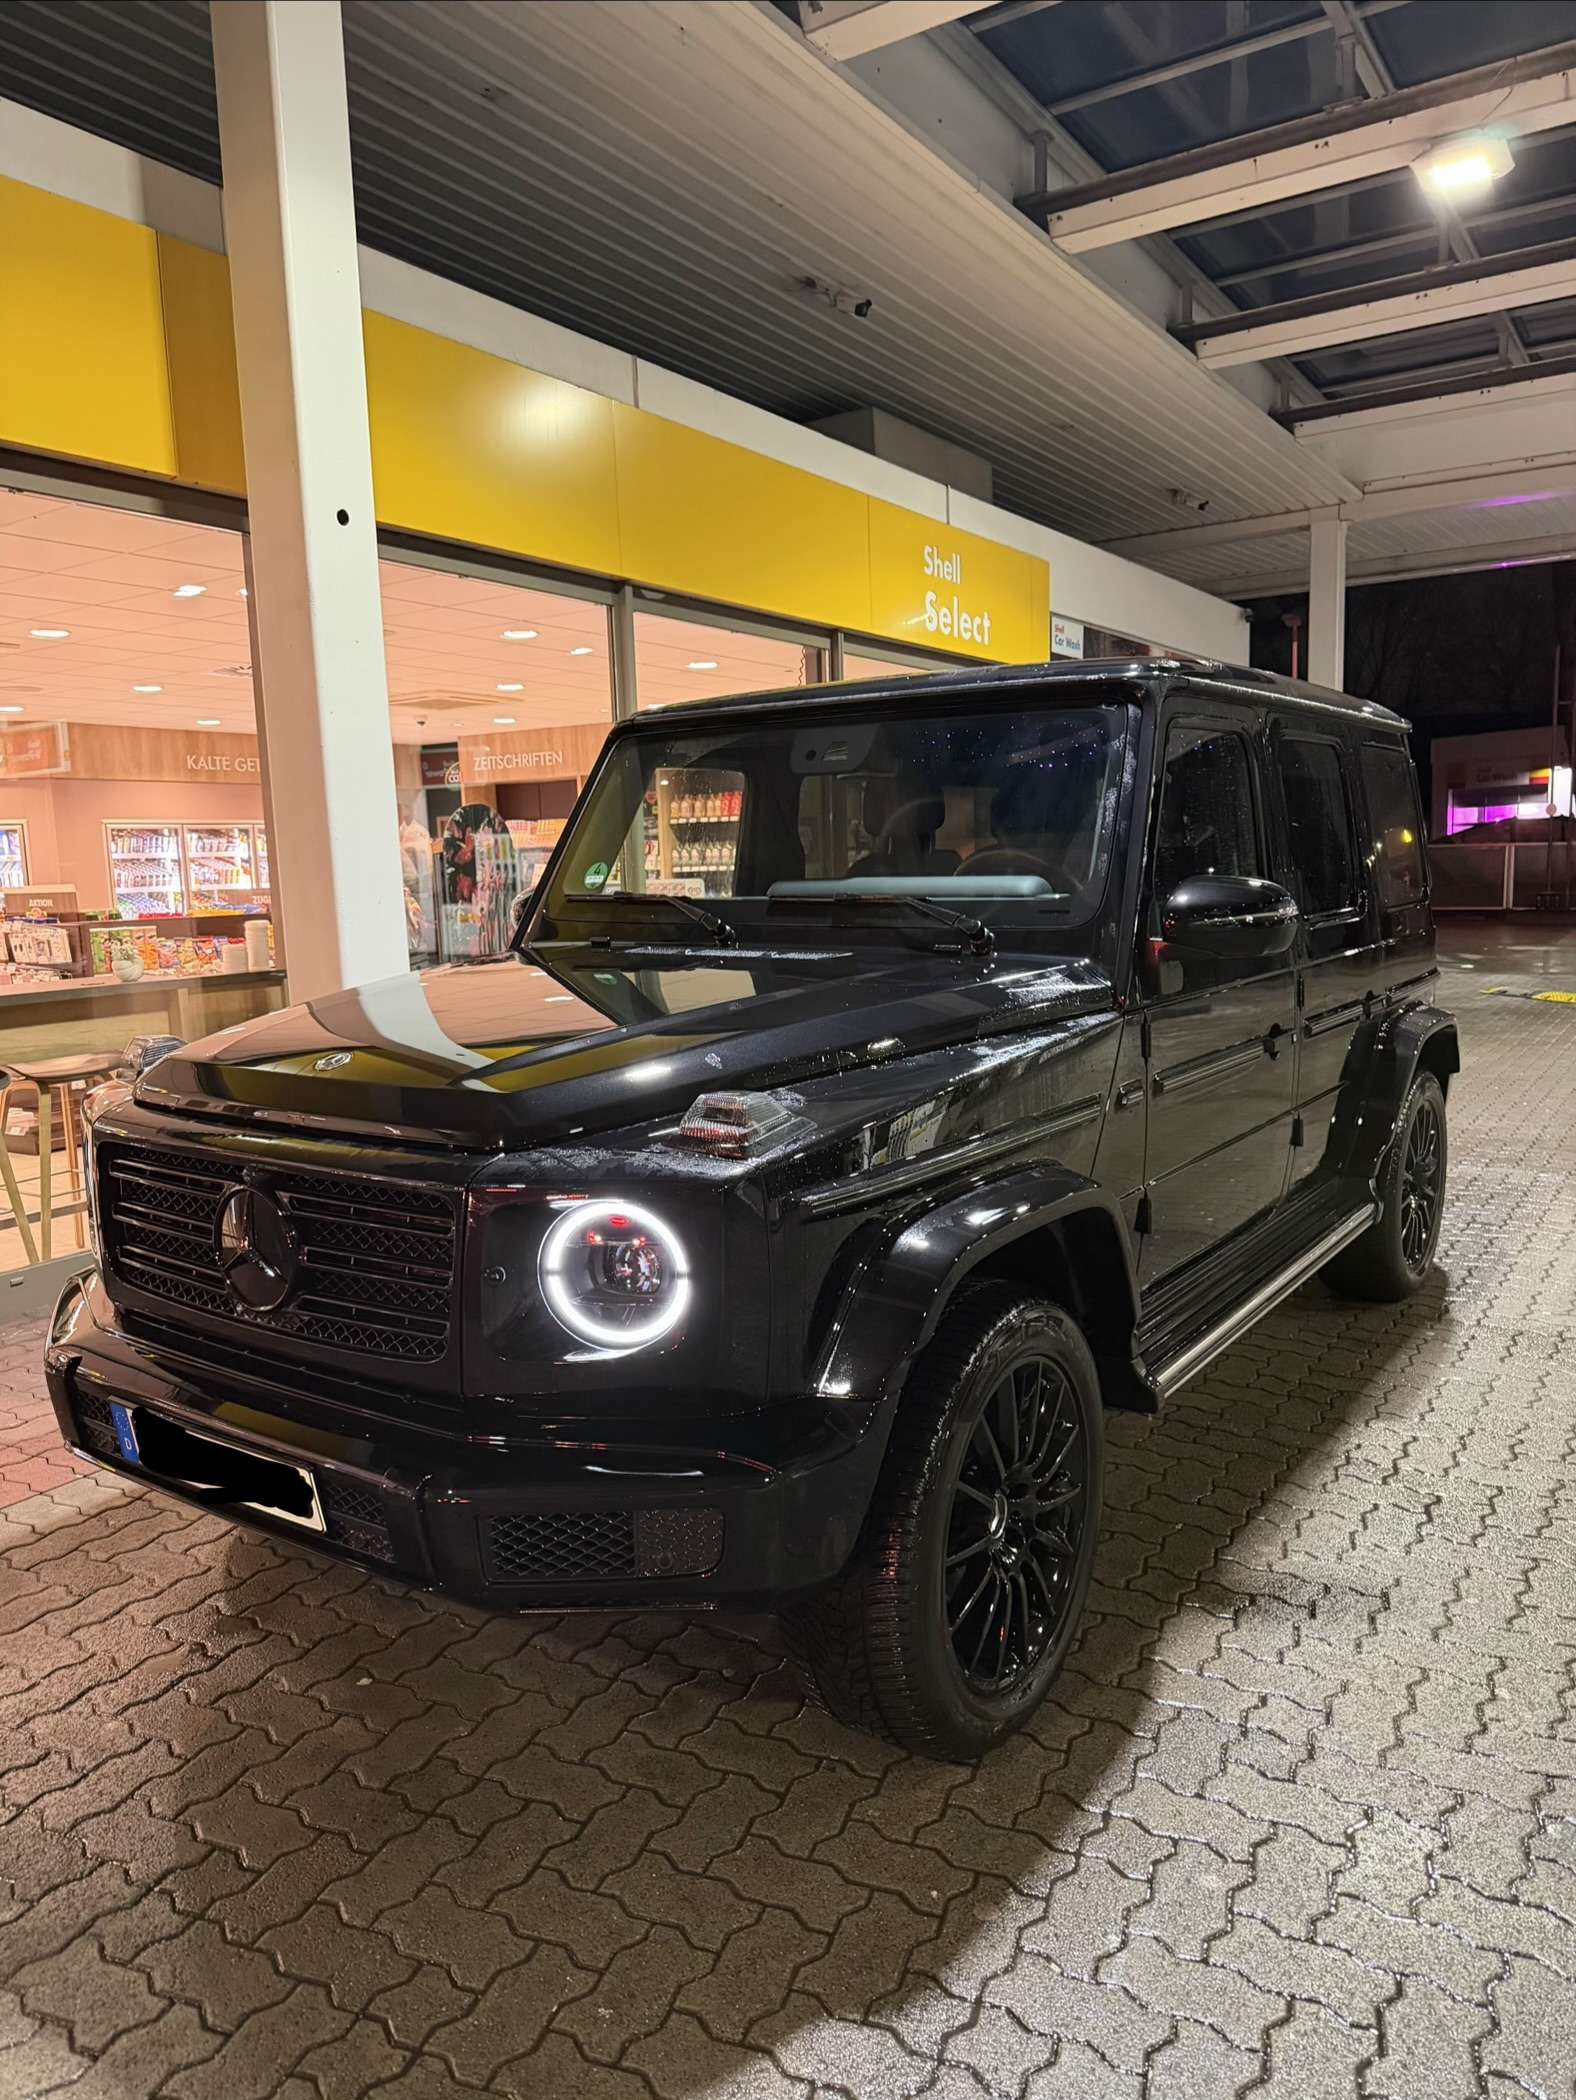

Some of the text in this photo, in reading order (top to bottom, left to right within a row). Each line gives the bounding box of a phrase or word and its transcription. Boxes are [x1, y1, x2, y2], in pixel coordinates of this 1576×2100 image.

[924, 545, 961, 584] Shell
[925, 591, 992, 645] Select
[1054, 635, 1081, 649] Car Wash
[186, 754, 231, 770] KALTE
[474, 751, 563, 771] ZEITSCHRIFTEN
[594, 863, 602, 876] 4
[124, 1437, 132, 1450] D
